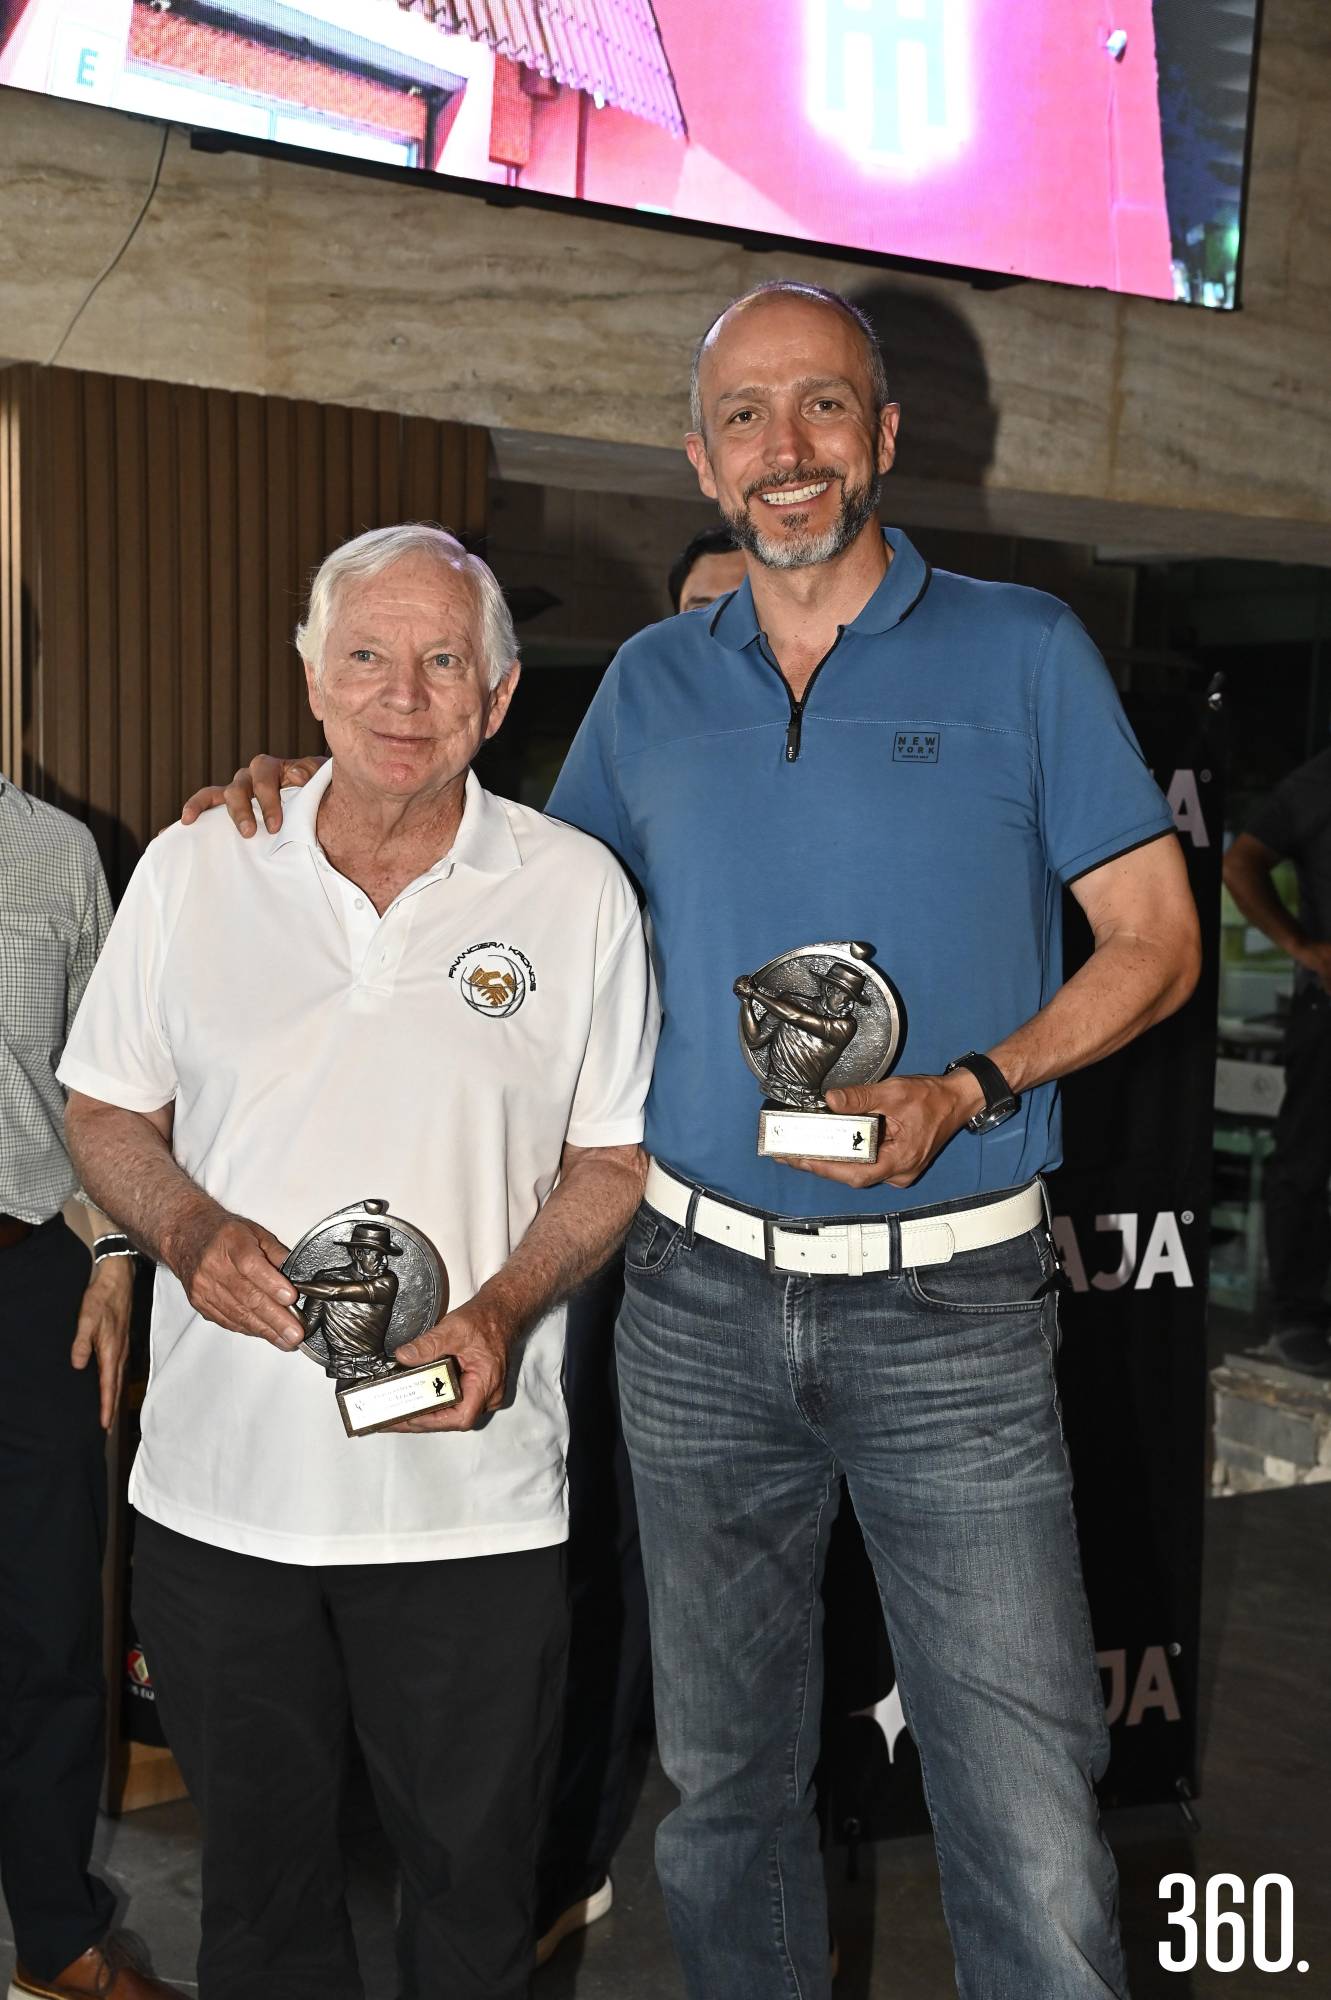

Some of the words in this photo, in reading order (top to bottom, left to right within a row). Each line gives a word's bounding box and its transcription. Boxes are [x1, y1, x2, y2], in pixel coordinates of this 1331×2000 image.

[77, 47, 98, 88] E
[898, 736, 936, 746] NEW
[897, 746, 935, 754] YORK
